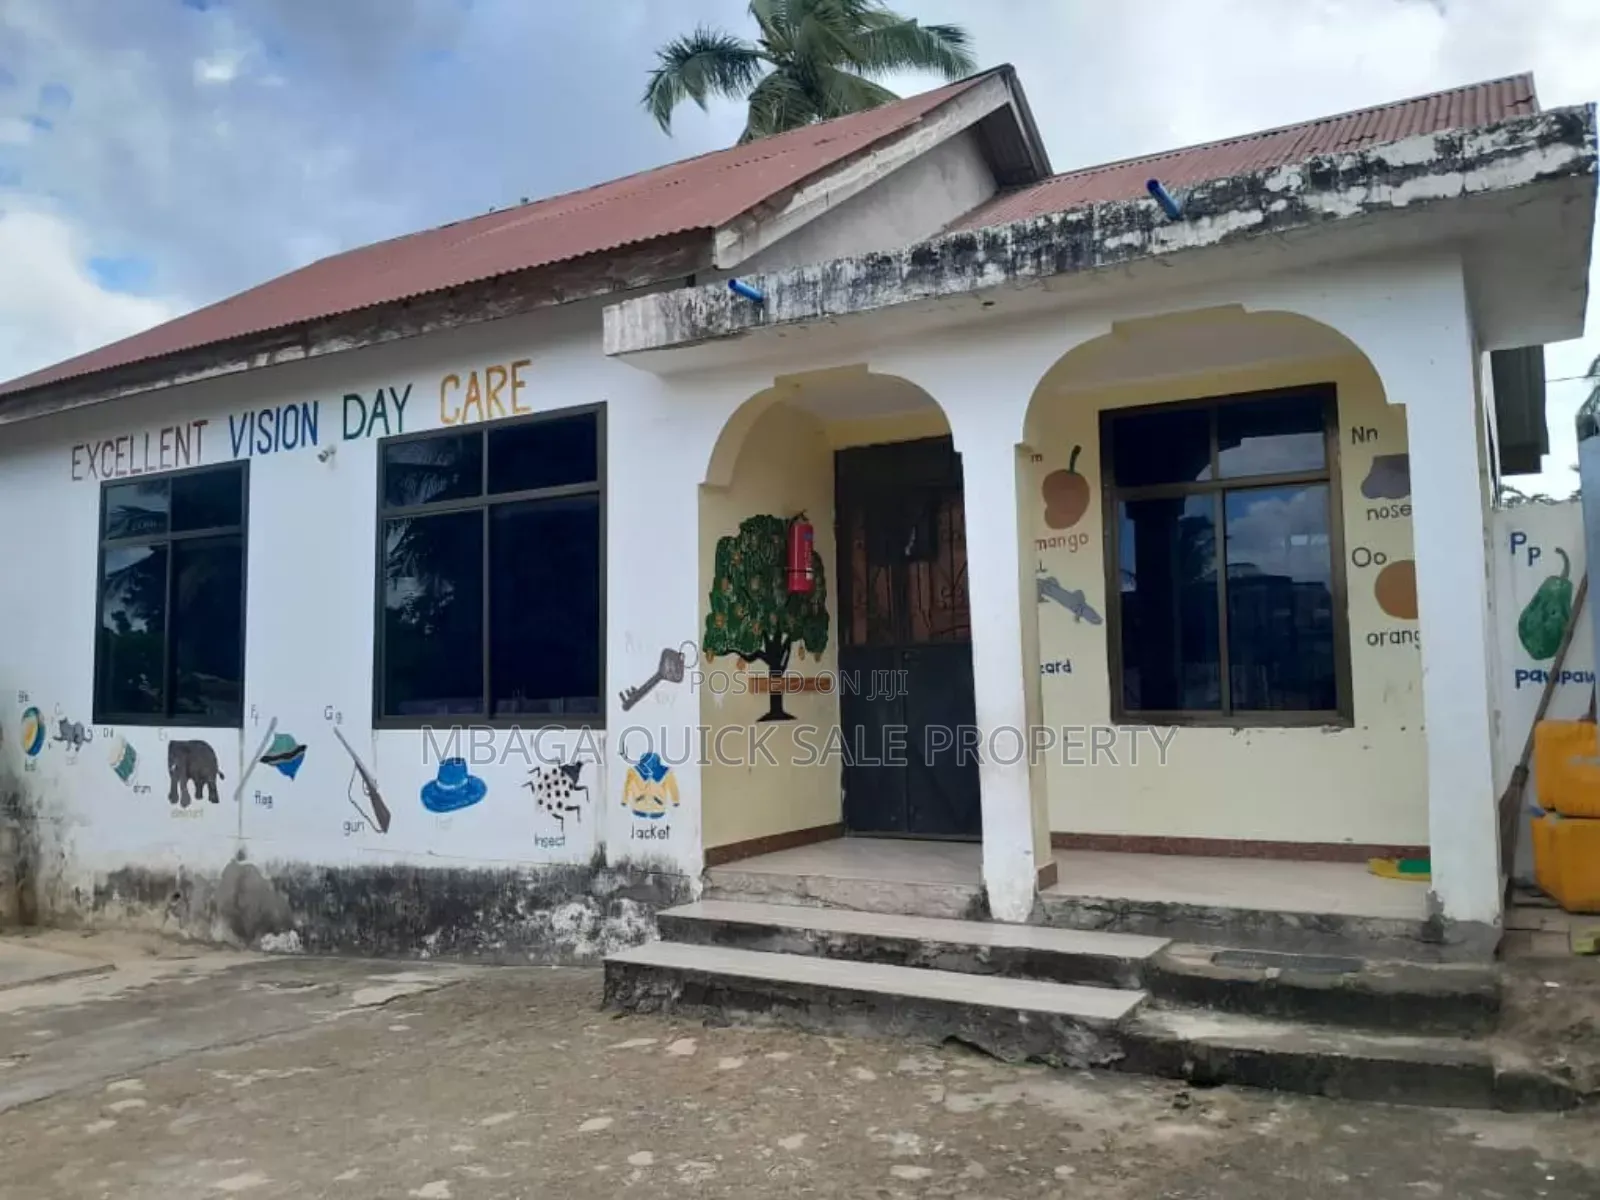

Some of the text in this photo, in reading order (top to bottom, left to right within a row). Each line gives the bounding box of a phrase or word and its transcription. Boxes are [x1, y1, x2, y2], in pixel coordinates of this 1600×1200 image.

[71, 359, 532, 482] EXCELLENT VISION DAY CARE
[1352, 426, 1378, 445] Nn
[1367, 504, 1412, 521] nose
[1352, 547, 1387, 567] Oo
